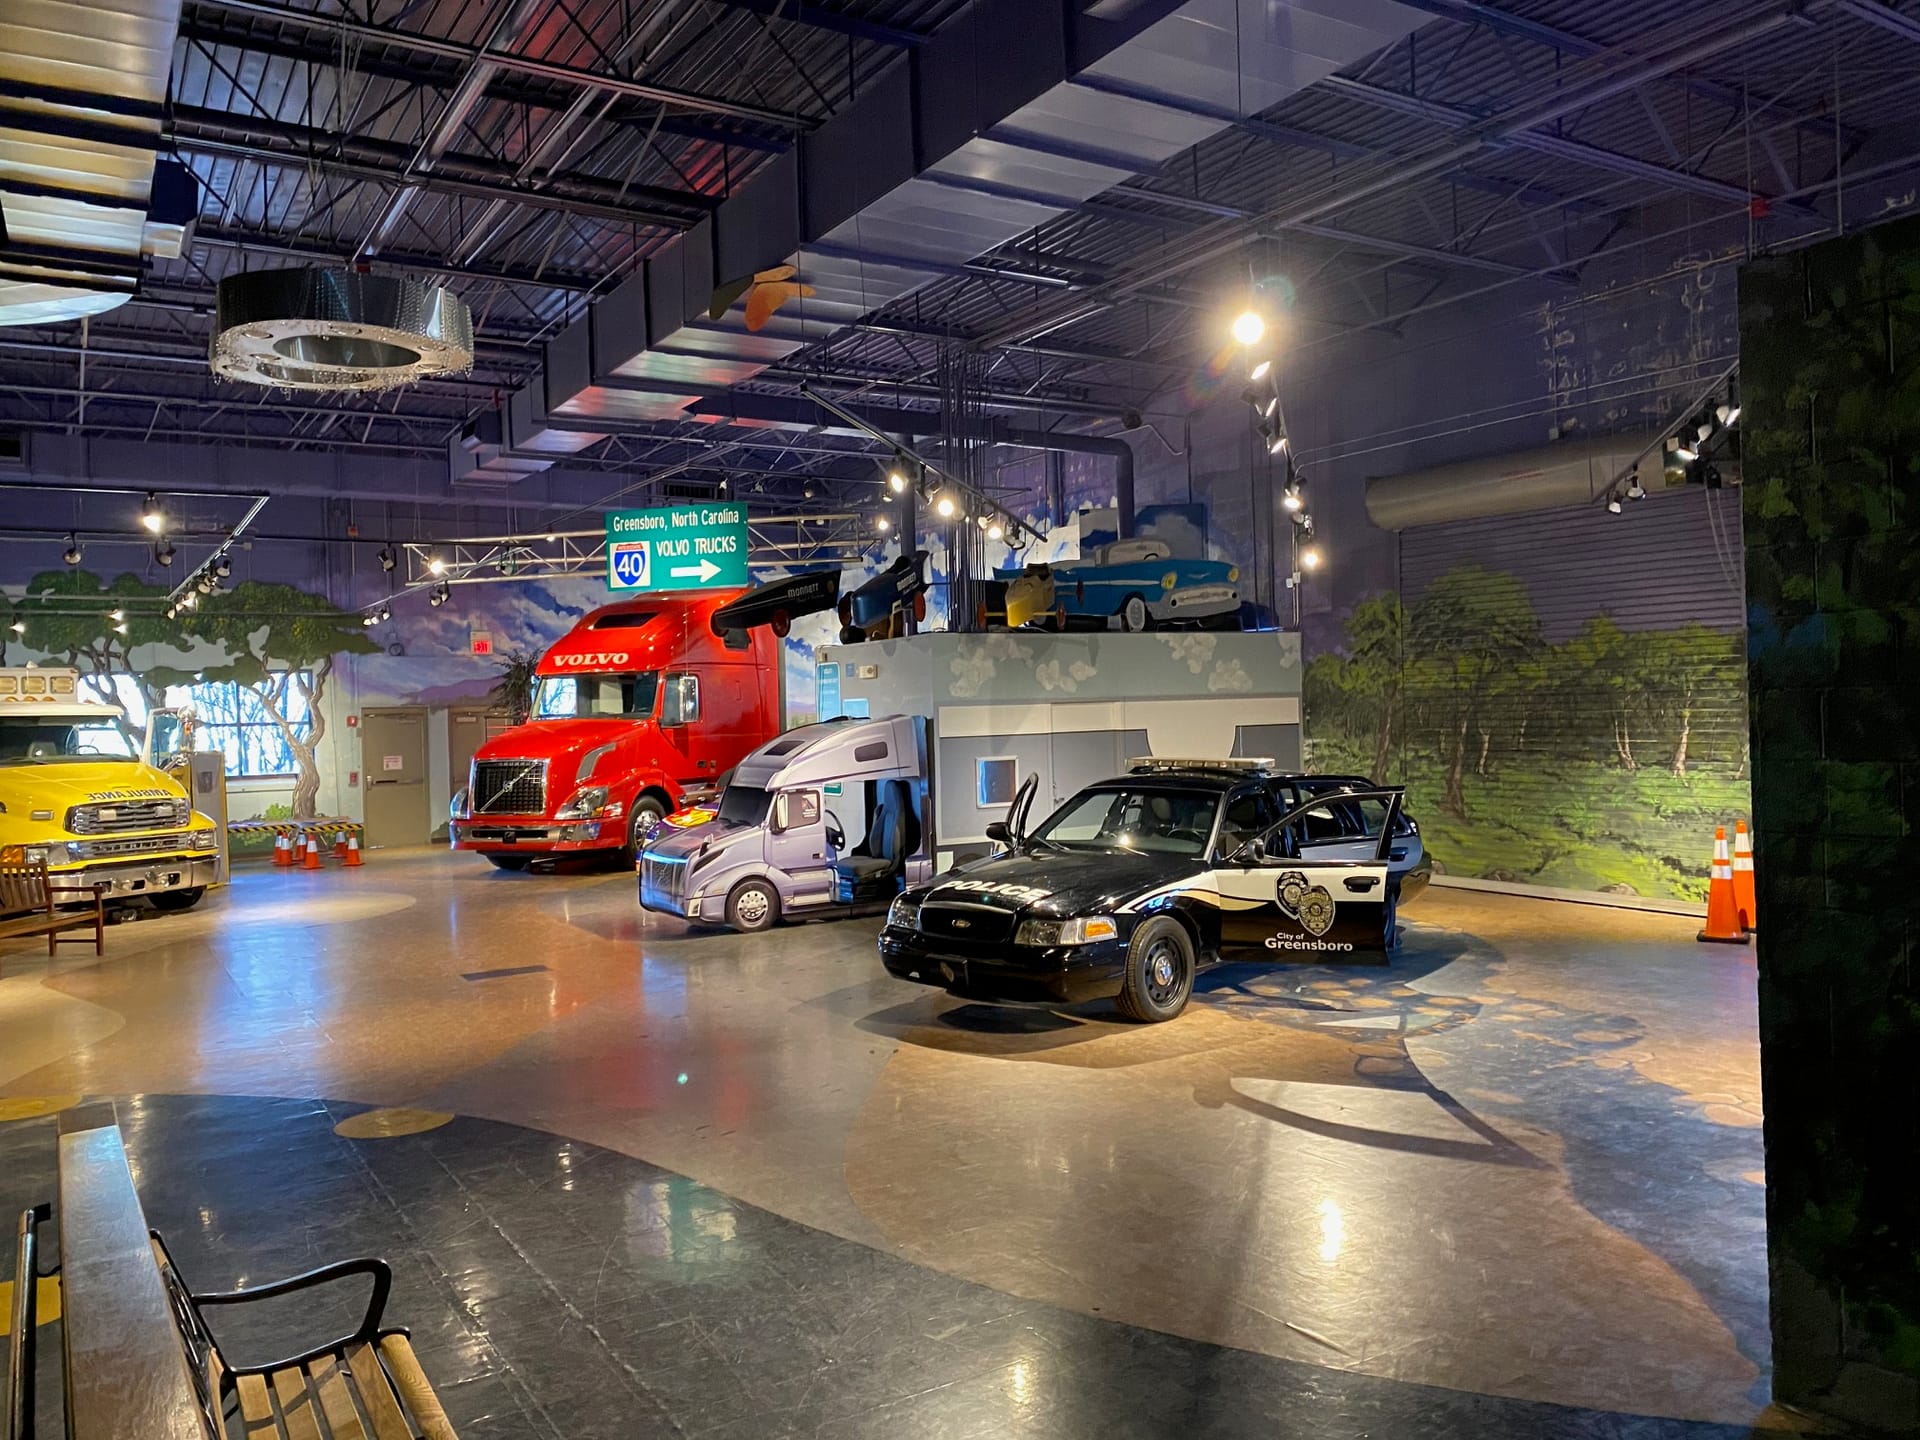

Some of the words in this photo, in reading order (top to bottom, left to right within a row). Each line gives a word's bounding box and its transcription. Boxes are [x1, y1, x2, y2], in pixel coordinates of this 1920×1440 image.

[613, 515, 668, 532] Greensboro,
[671, 512, 698, 528] North
[701, 508, 739, 526] Carolina
[656, 538, 689, 557] VOLVO
[694, 535, 736, 554] TRUCKS
[617, 552, 643, 577] 40
[553, 652, 629, 667] VOLVO
[935, 880, 1054, 905] POLICE
[1265, 937, 1354, 952] Greensboro
[1276, 932, 1294, 941] City
